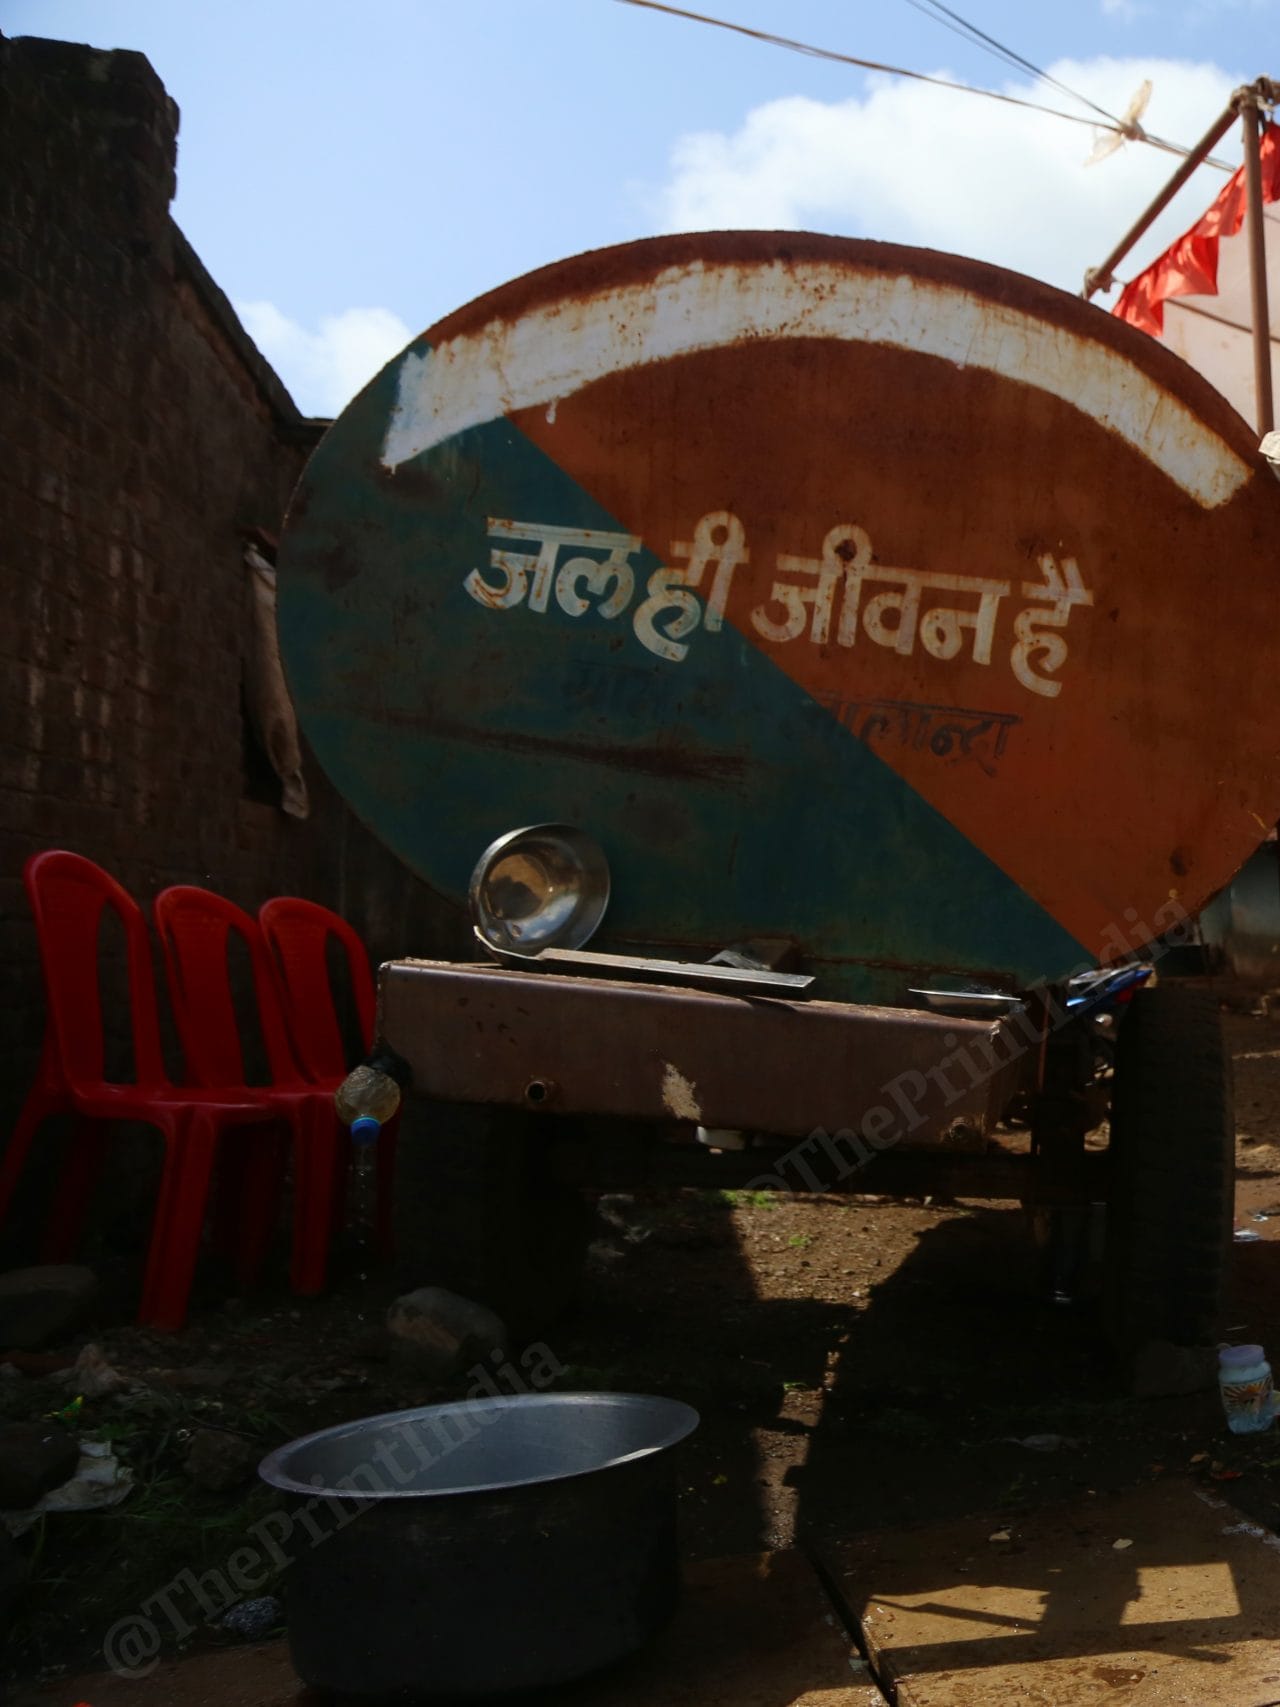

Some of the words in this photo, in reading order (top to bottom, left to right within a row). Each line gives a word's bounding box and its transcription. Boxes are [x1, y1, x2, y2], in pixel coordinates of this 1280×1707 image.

[463, 516, 642, 613] जल
[633, 510, 749, 662] ही
[750, 524, 1011, 666] जीवन
[1009, 554, 1094, 698] है
